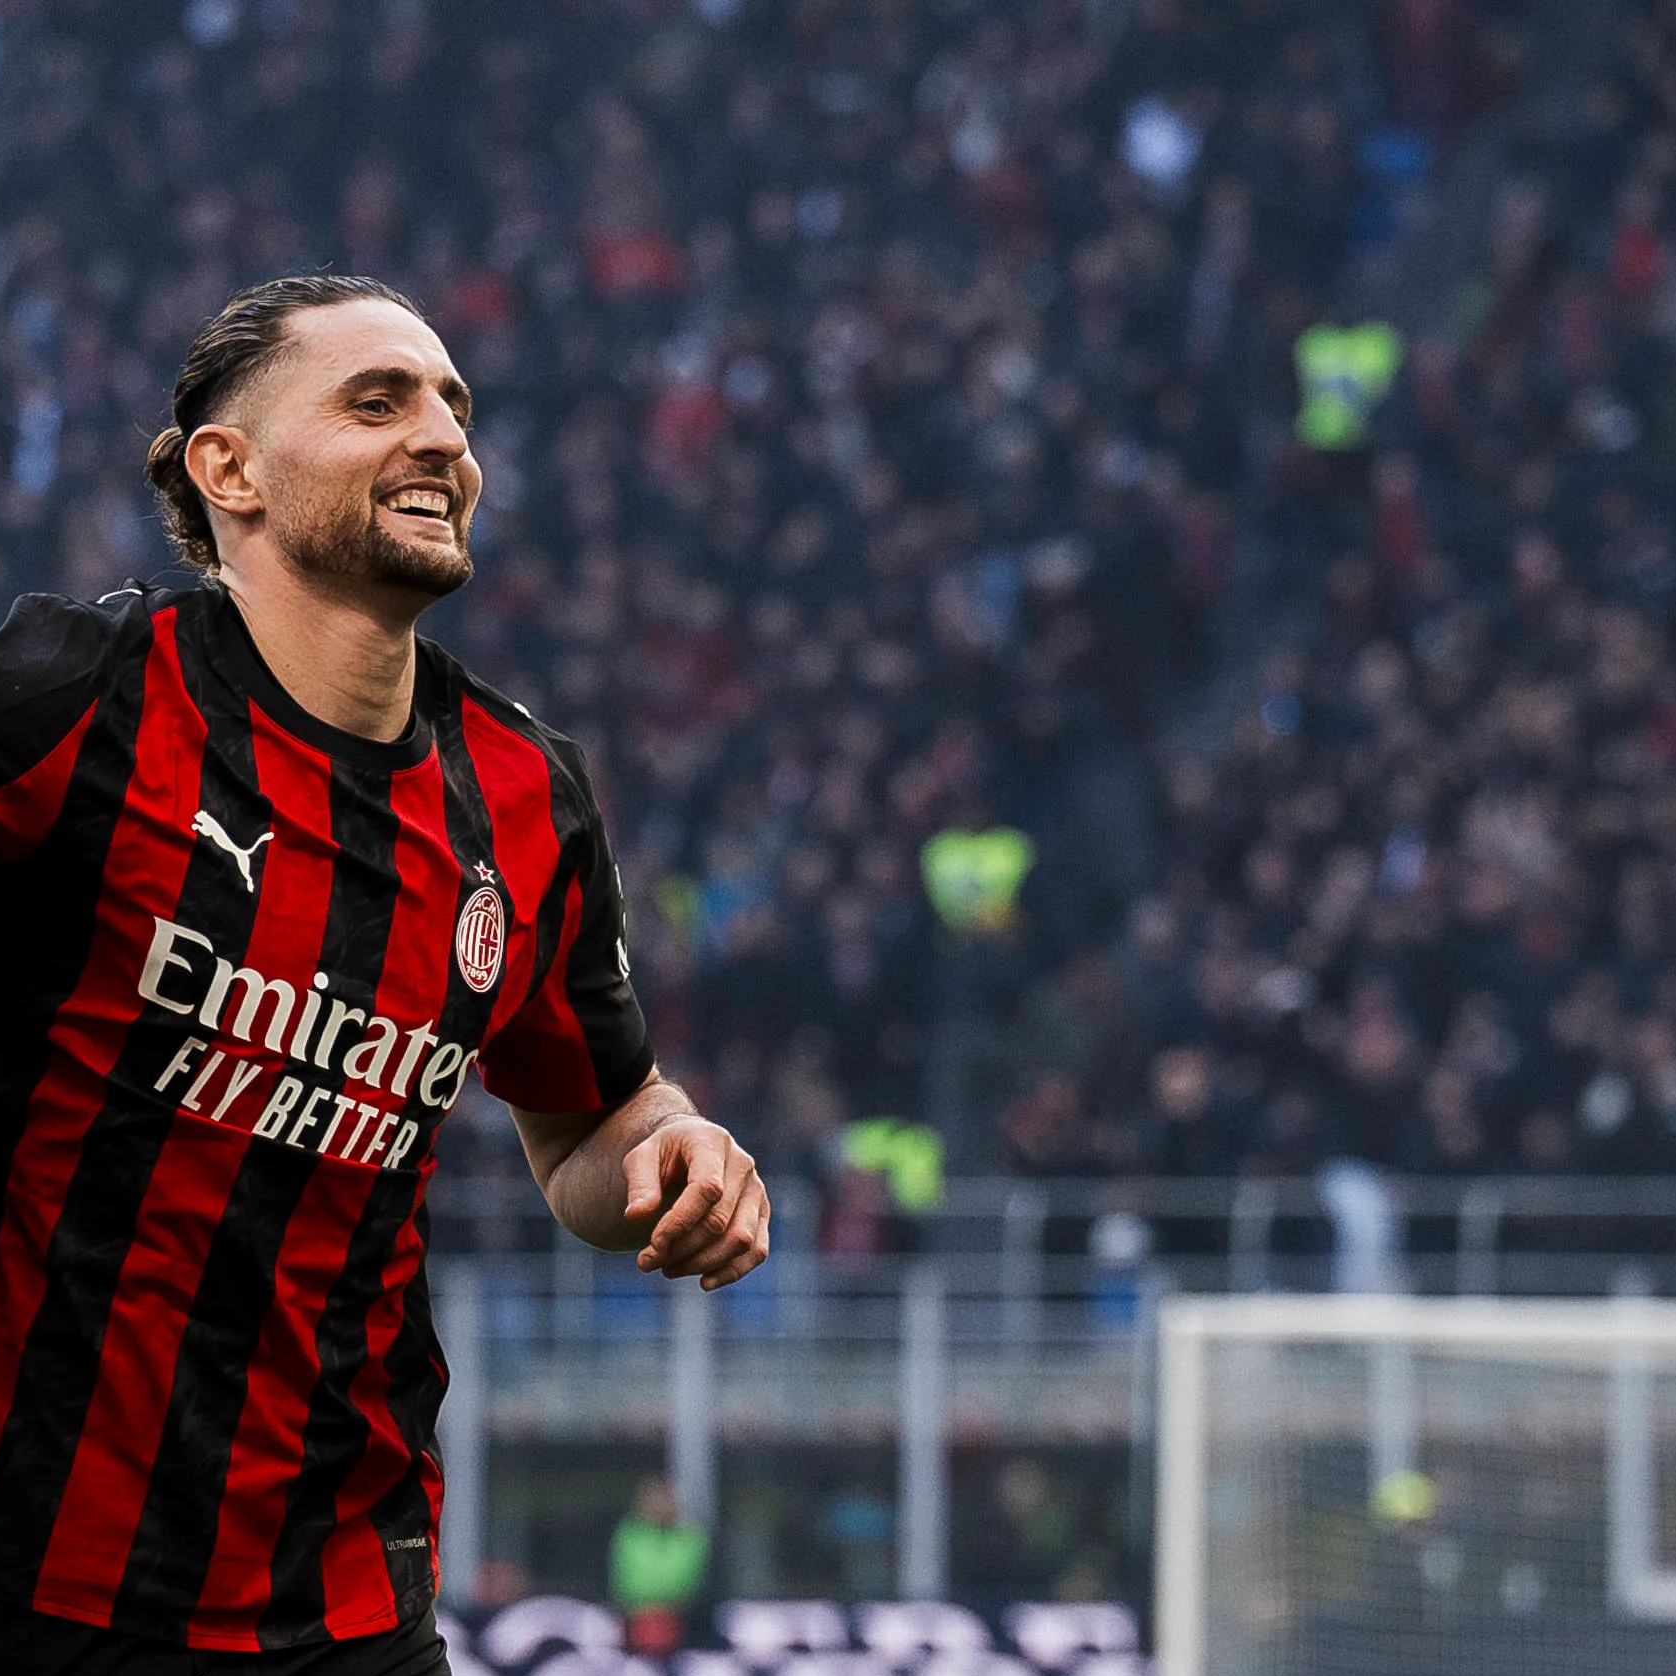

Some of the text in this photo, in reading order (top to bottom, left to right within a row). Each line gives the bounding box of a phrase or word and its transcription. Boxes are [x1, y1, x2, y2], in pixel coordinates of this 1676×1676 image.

[138, 916, 477, 1110] Emirates
[466, 965, 488, 981] 1899
[153, 1036, 419, 1169] FLY BETTER
